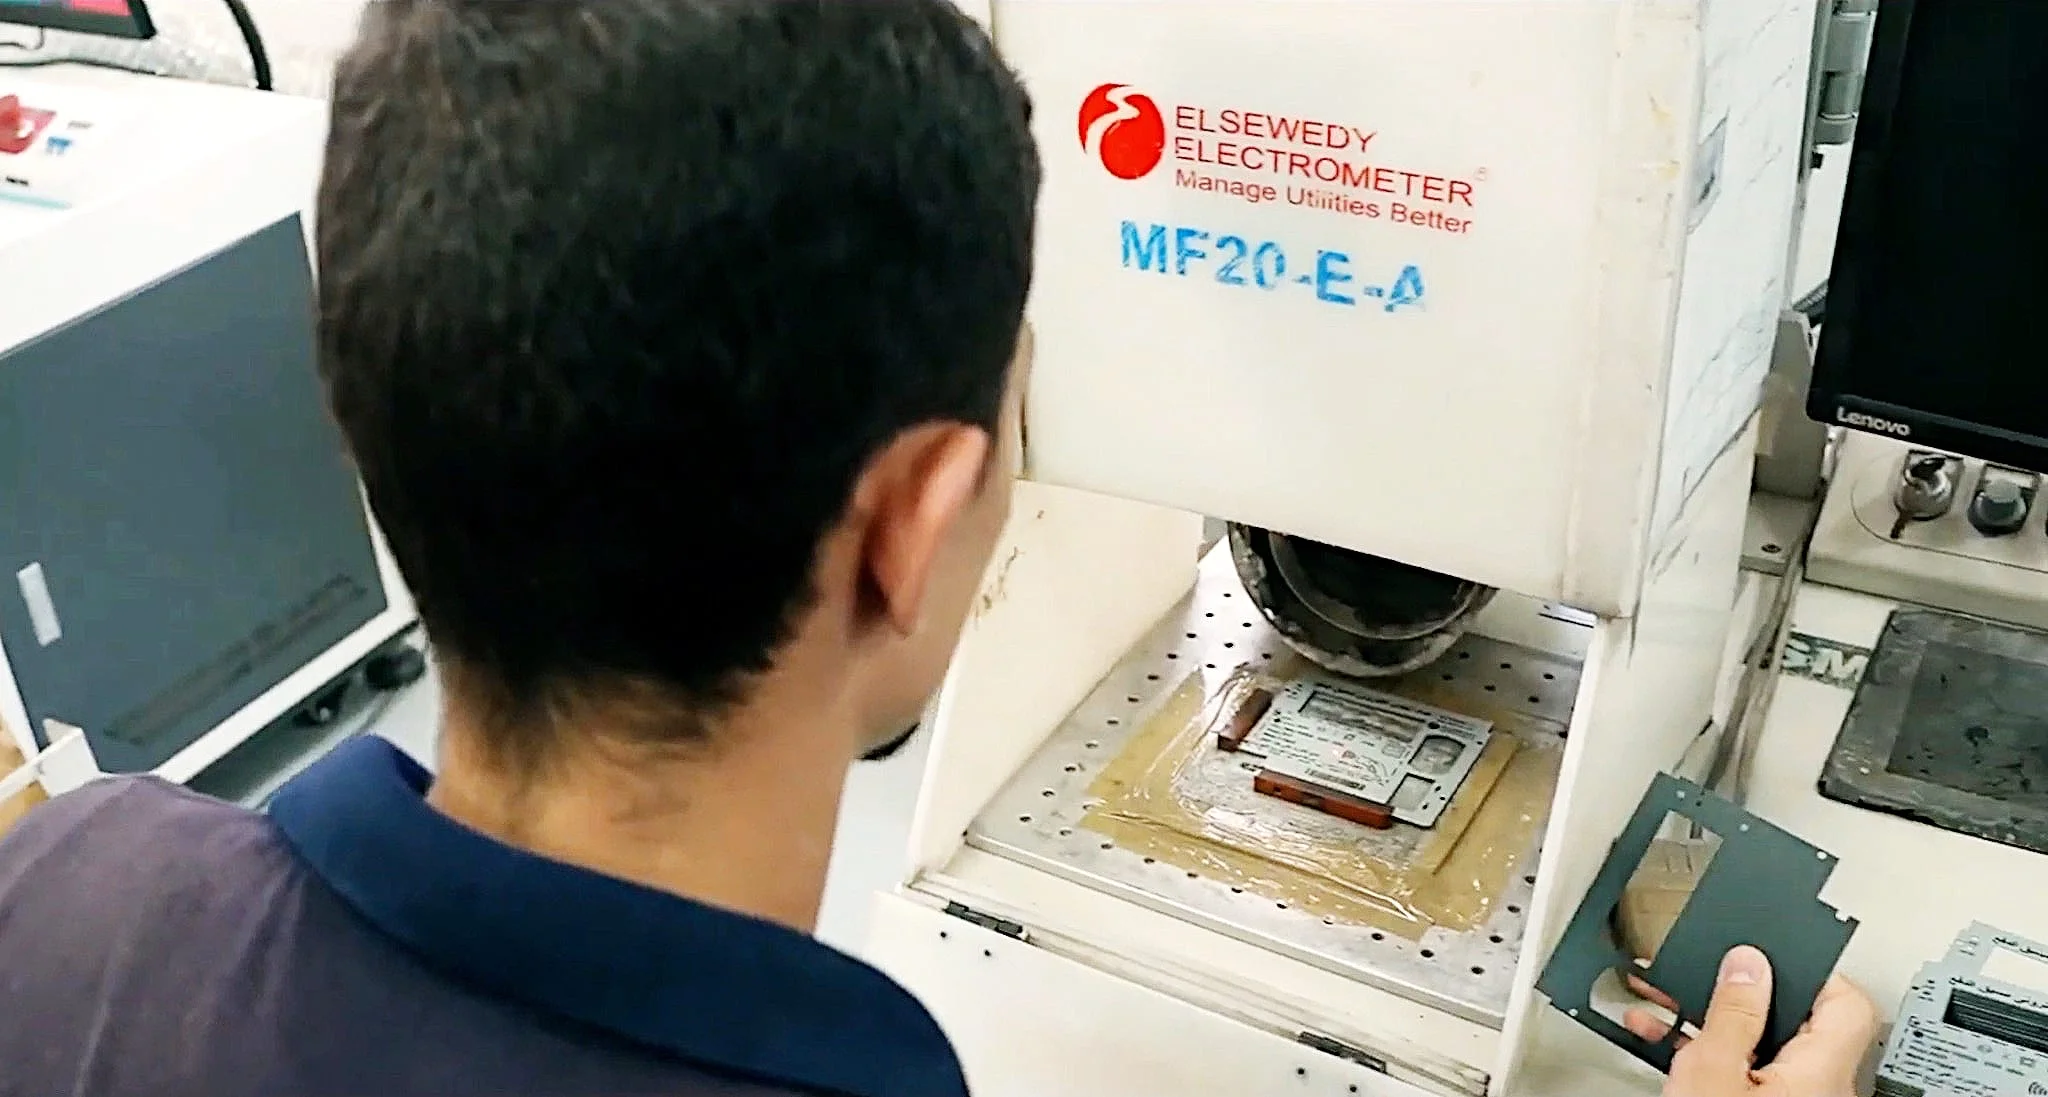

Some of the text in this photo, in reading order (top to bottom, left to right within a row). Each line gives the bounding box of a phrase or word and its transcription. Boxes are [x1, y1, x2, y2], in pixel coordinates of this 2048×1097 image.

[1176, 105, 1377, 154] ELSEWEDY
[1175, 136, 1474, 206] ELECTROMETER
[1175, 167, 1473, 234] Manage Utilities Better
[1120, 219, 1427, 312] MF20-E-A
[1836, 406, 1911, 436] Lenovo
